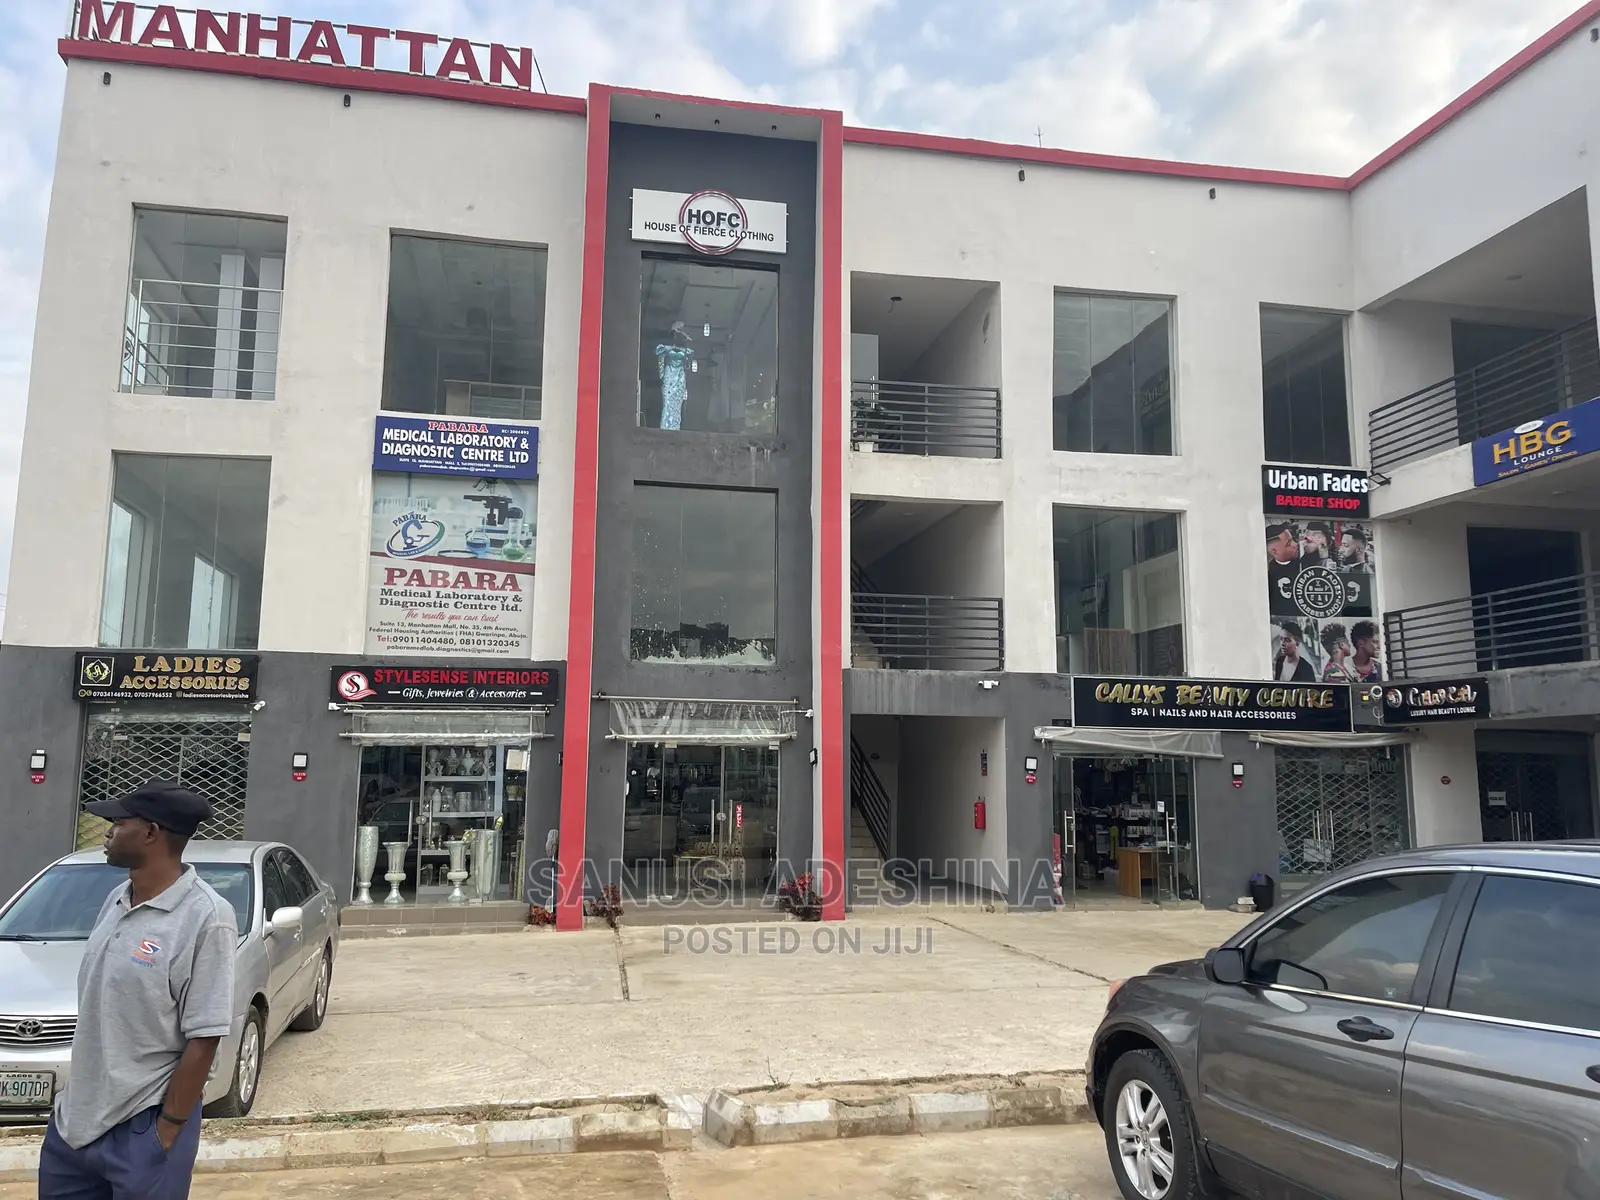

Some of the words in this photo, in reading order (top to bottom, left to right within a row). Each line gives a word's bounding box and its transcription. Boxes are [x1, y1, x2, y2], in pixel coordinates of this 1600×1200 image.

[77, 0, 532, 90] MANHATTAN
[687, 208, 741, 228] HOFC
[644, 221, 677, 233] HOUSE
[679, 224, 691, 234] OF
[693, 226, 727, 237] FIERCE
[728, 229, 774, 242] CLOTHING
[428, 421, 489, 434] PABARA
[382, 428, 434, 443] MEDICAL
[440, 431, 517, 449] LABORATORY
[520, 437, 529, 450] &
[1493, 420, 1572, 465] HBG
[381, 443, 455, 459] DIAGNOSTIC
[461, 448, 504, 462] CENTRE
[509, 452, 529, 464] LTD
[1513, 445, 1563, 466] LOUNGE
[1268, 469, 1318, 491] Urban
[1322, 473, 1369, 493] Fades
[1276, 494, 1324, 508] BARBER
[1327, 497, 1360, 510] SHOP
[392, 511, 427, 526] PABARA
[383, 567, 522, 592] PABARA
[1296, 569, 1315, 595] URBAN
[1321, 570, 1342, 595] FADES
[380, 588, 432, 598] Medical
[435, 590, 509, 603] Laboratory
[512, 594, 523, 603] &
[379, 597, 450, 609] Diagnostic
[453, 600, 497, 611] Centre
[500, 601, 522, 612] ltd.
[1298, 598, 1325, 618] BARBER
[402, 608, 419, 620] The
[421, 610, 446, 621] results
[448, 614, 462, 623] you
[480, 613, 500, 623] trust
[394, 628, 419, 636] Housing
[476, 631, 507, 639] Gwarinpa,
[386, 644, 510, 654] pabaramedlab.diagnostics@gmail.com
[459, 638, 520, 647] 08101320345
[132, 655, 242, 674] LADIES
[119, 675, 250, 690] ACCESSORIES
[373, 668, 469, 684] STYLESENSE
[473, 670, 549, 685] INTERIORS
[402, 687, 425, 699] Gifts,
[467, 688, 477, 699] &
[479, 689, 527, 698] Accessories
[1095, 682, 1165, 704] CALLYS
[1176, 685, 1251, 706] BEAUTY
[1256, 687, 1334, 708] CENTRE
[1131, 708, 1149, 716] SPA
[1159, 709, 1187, 718] NAILS
[1189, 709, 1208, 718] AND
[1210, 710, 1233, 719] HAIR
[1235, 710, 1297, 720] ACCESSORIES
[1438, 707, 1456, 715] BEAUTY
[0, 1081, 50, 1097] K-907DP
